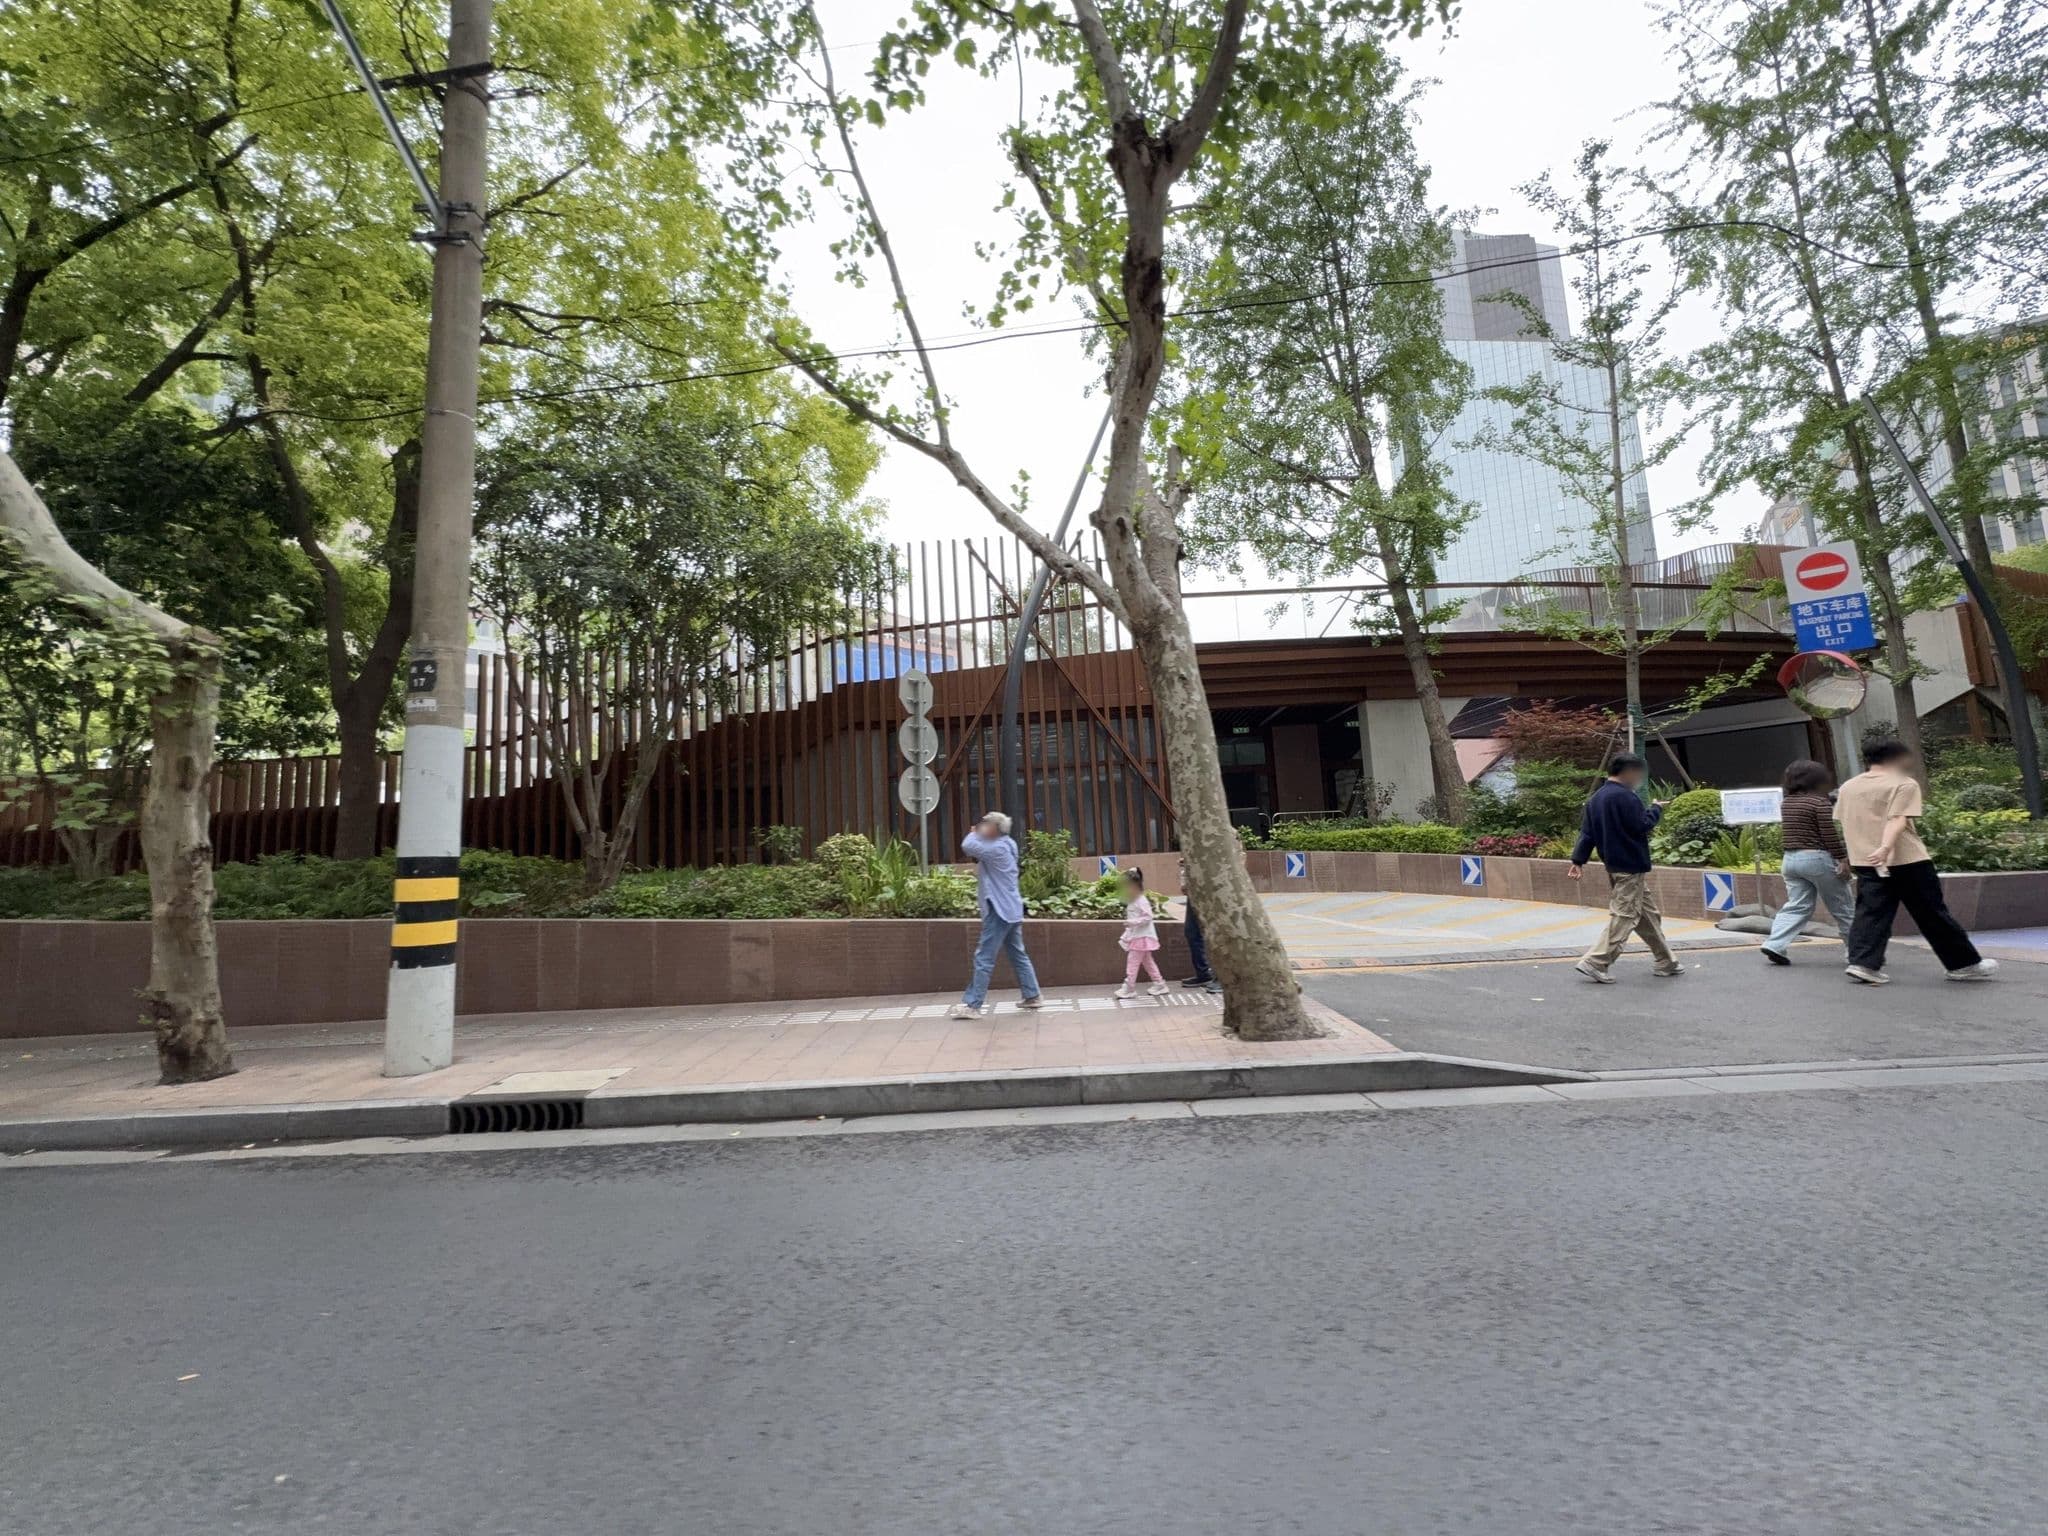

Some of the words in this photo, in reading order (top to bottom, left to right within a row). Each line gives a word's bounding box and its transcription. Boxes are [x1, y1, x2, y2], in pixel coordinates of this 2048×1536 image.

[1797, 597, 1863, 616] 地下车库
[1798, 615, 1832, 626] BASEMENT
[1833, 611, 1864, 620] PARKING
[1816, 622, 1852, 638] 出口
[1825, 637, 1845, 646] EXIT
